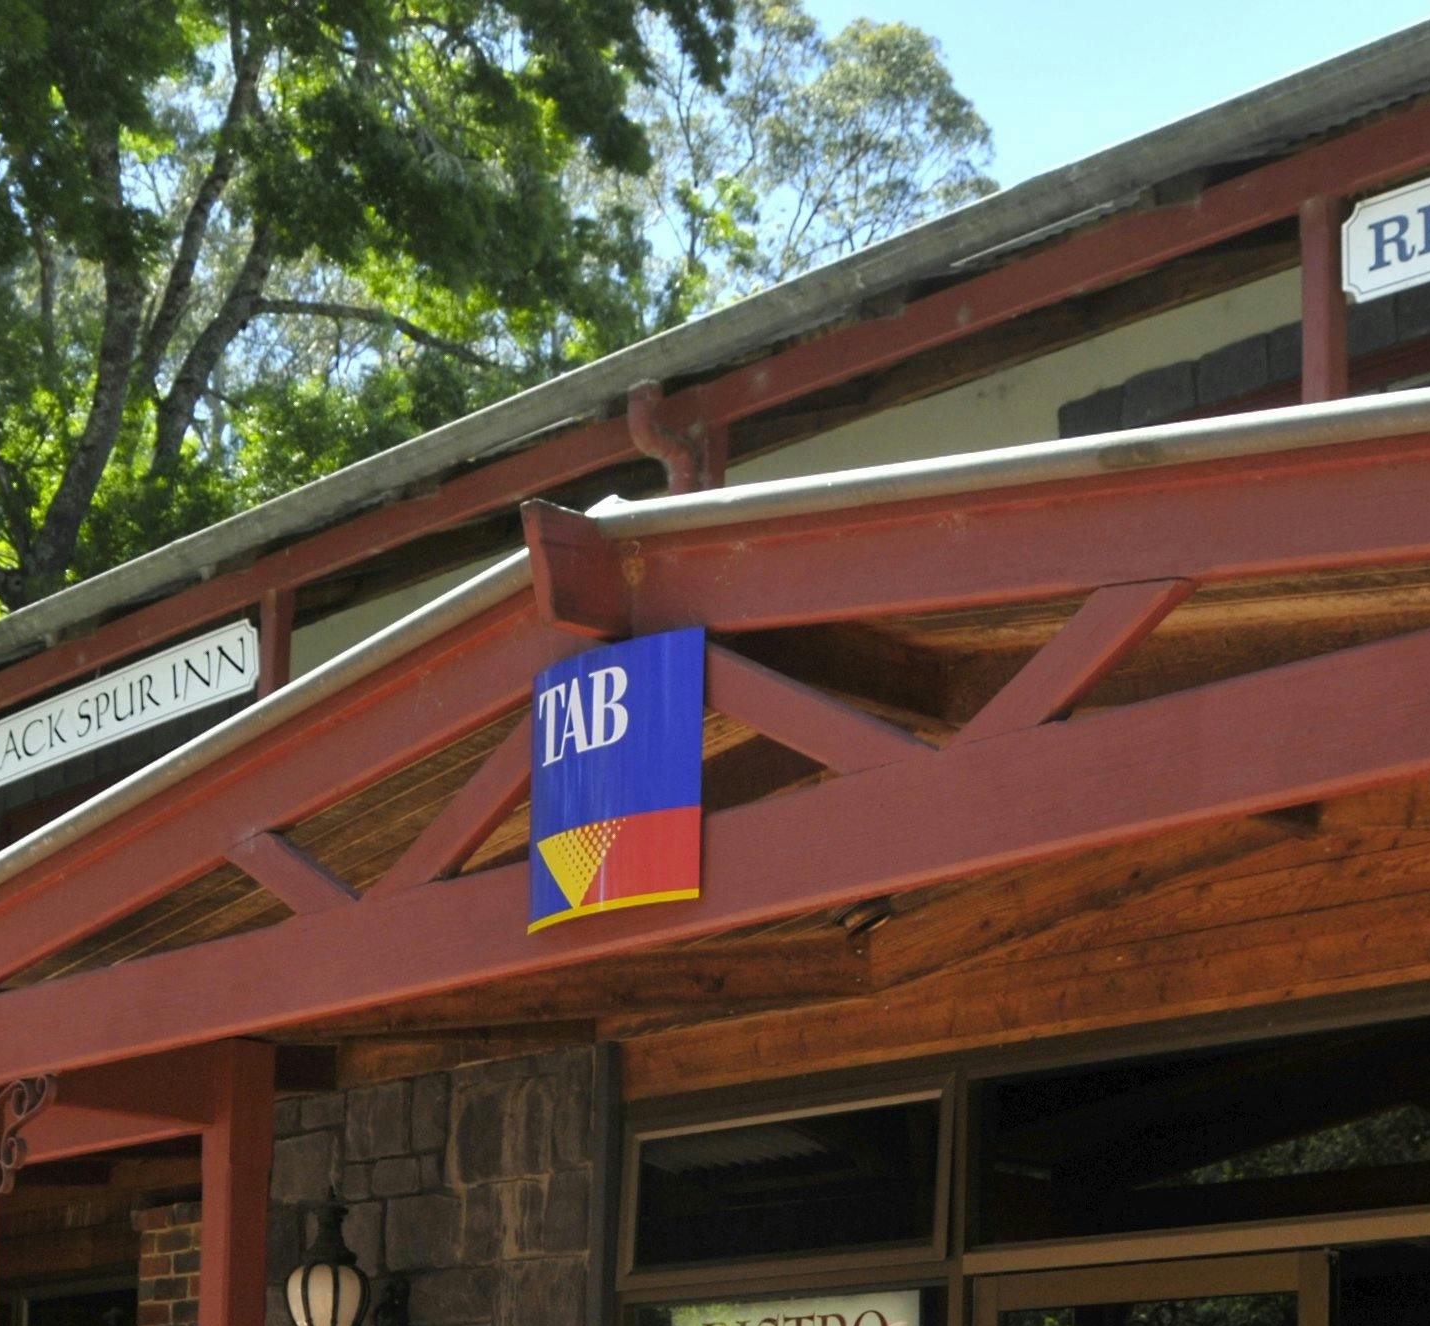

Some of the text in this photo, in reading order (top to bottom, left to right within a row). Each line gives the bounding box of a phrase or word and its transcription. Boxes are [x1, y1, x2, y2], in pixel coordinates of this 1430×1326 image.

[76, 674, 160, 738] SPUR
[171, 636, 245, 701] INN
[538, 665, 629, 768] TAB
